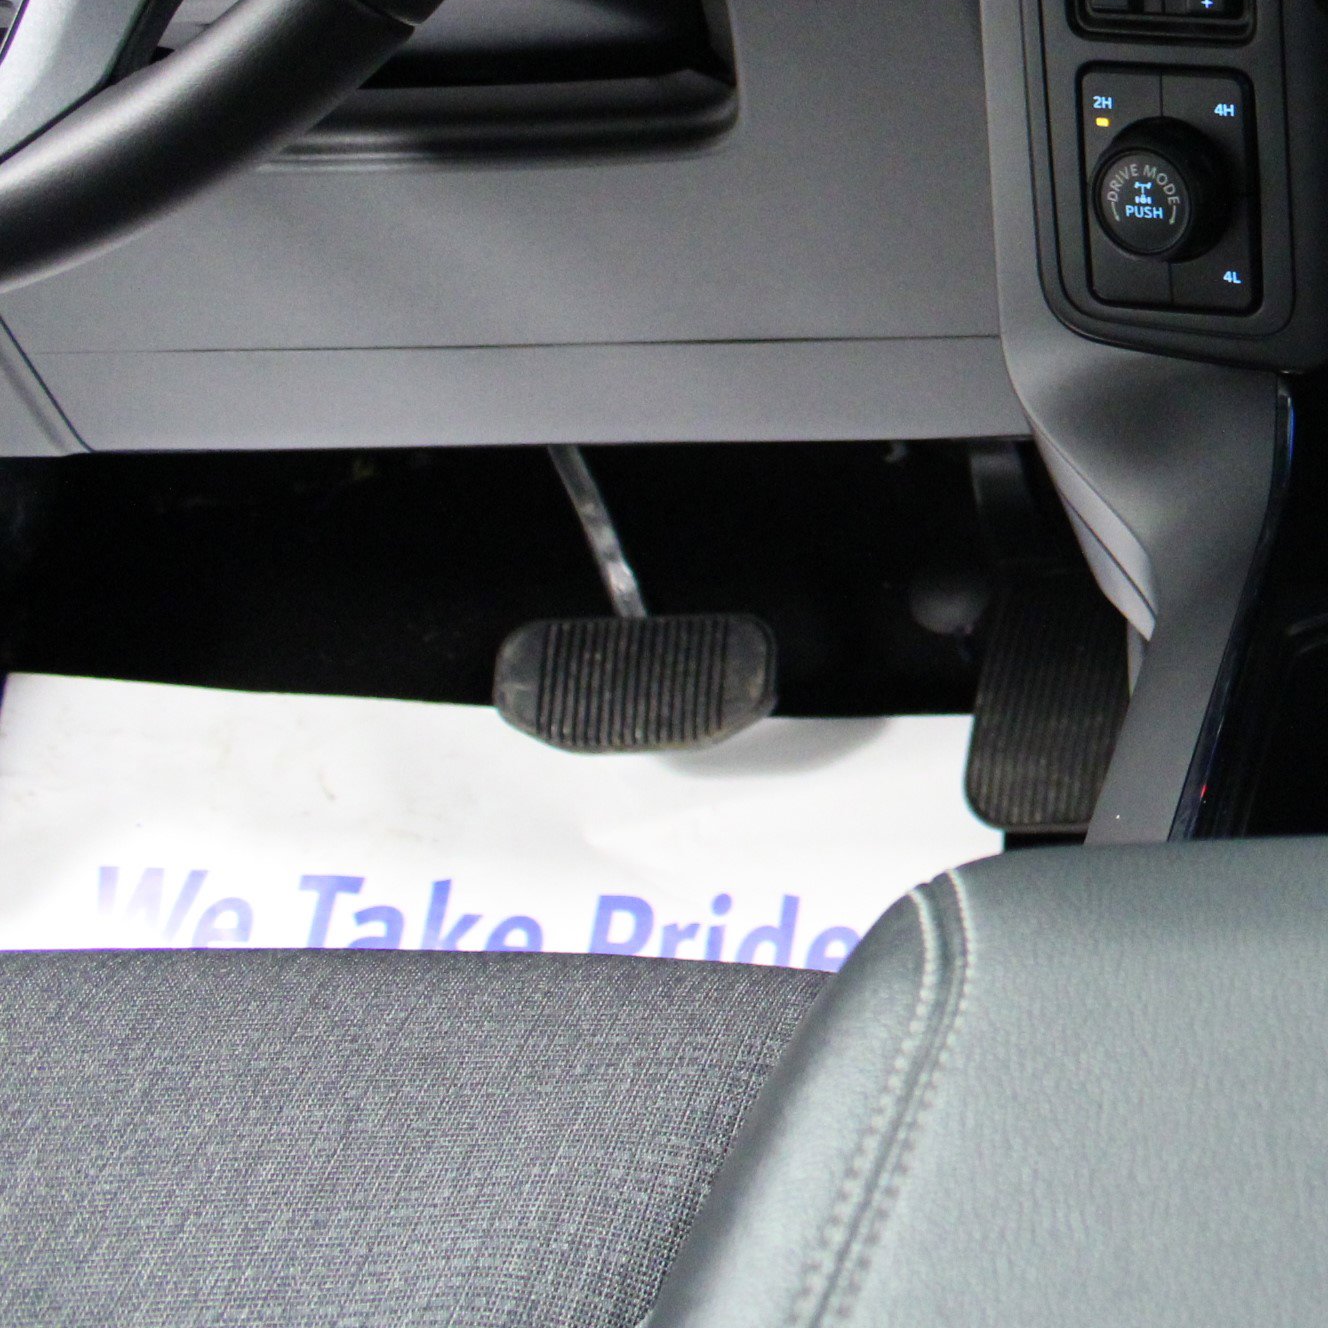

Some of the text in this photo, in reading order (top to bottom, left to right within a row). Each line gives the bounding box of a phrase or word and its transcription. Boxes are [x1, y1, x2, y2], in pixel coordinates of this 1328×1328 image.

[1092, 95, 1113, 110] 2H
[1213, 103, 1235, 118] 4H
[1106, 163, 1181, 206] DRIVE MODE
[1124, 204, 1165, 220] PUSH
[1222, 271, 1242, 284] 4L
[97, 865, 862, 973] We Take Pride
